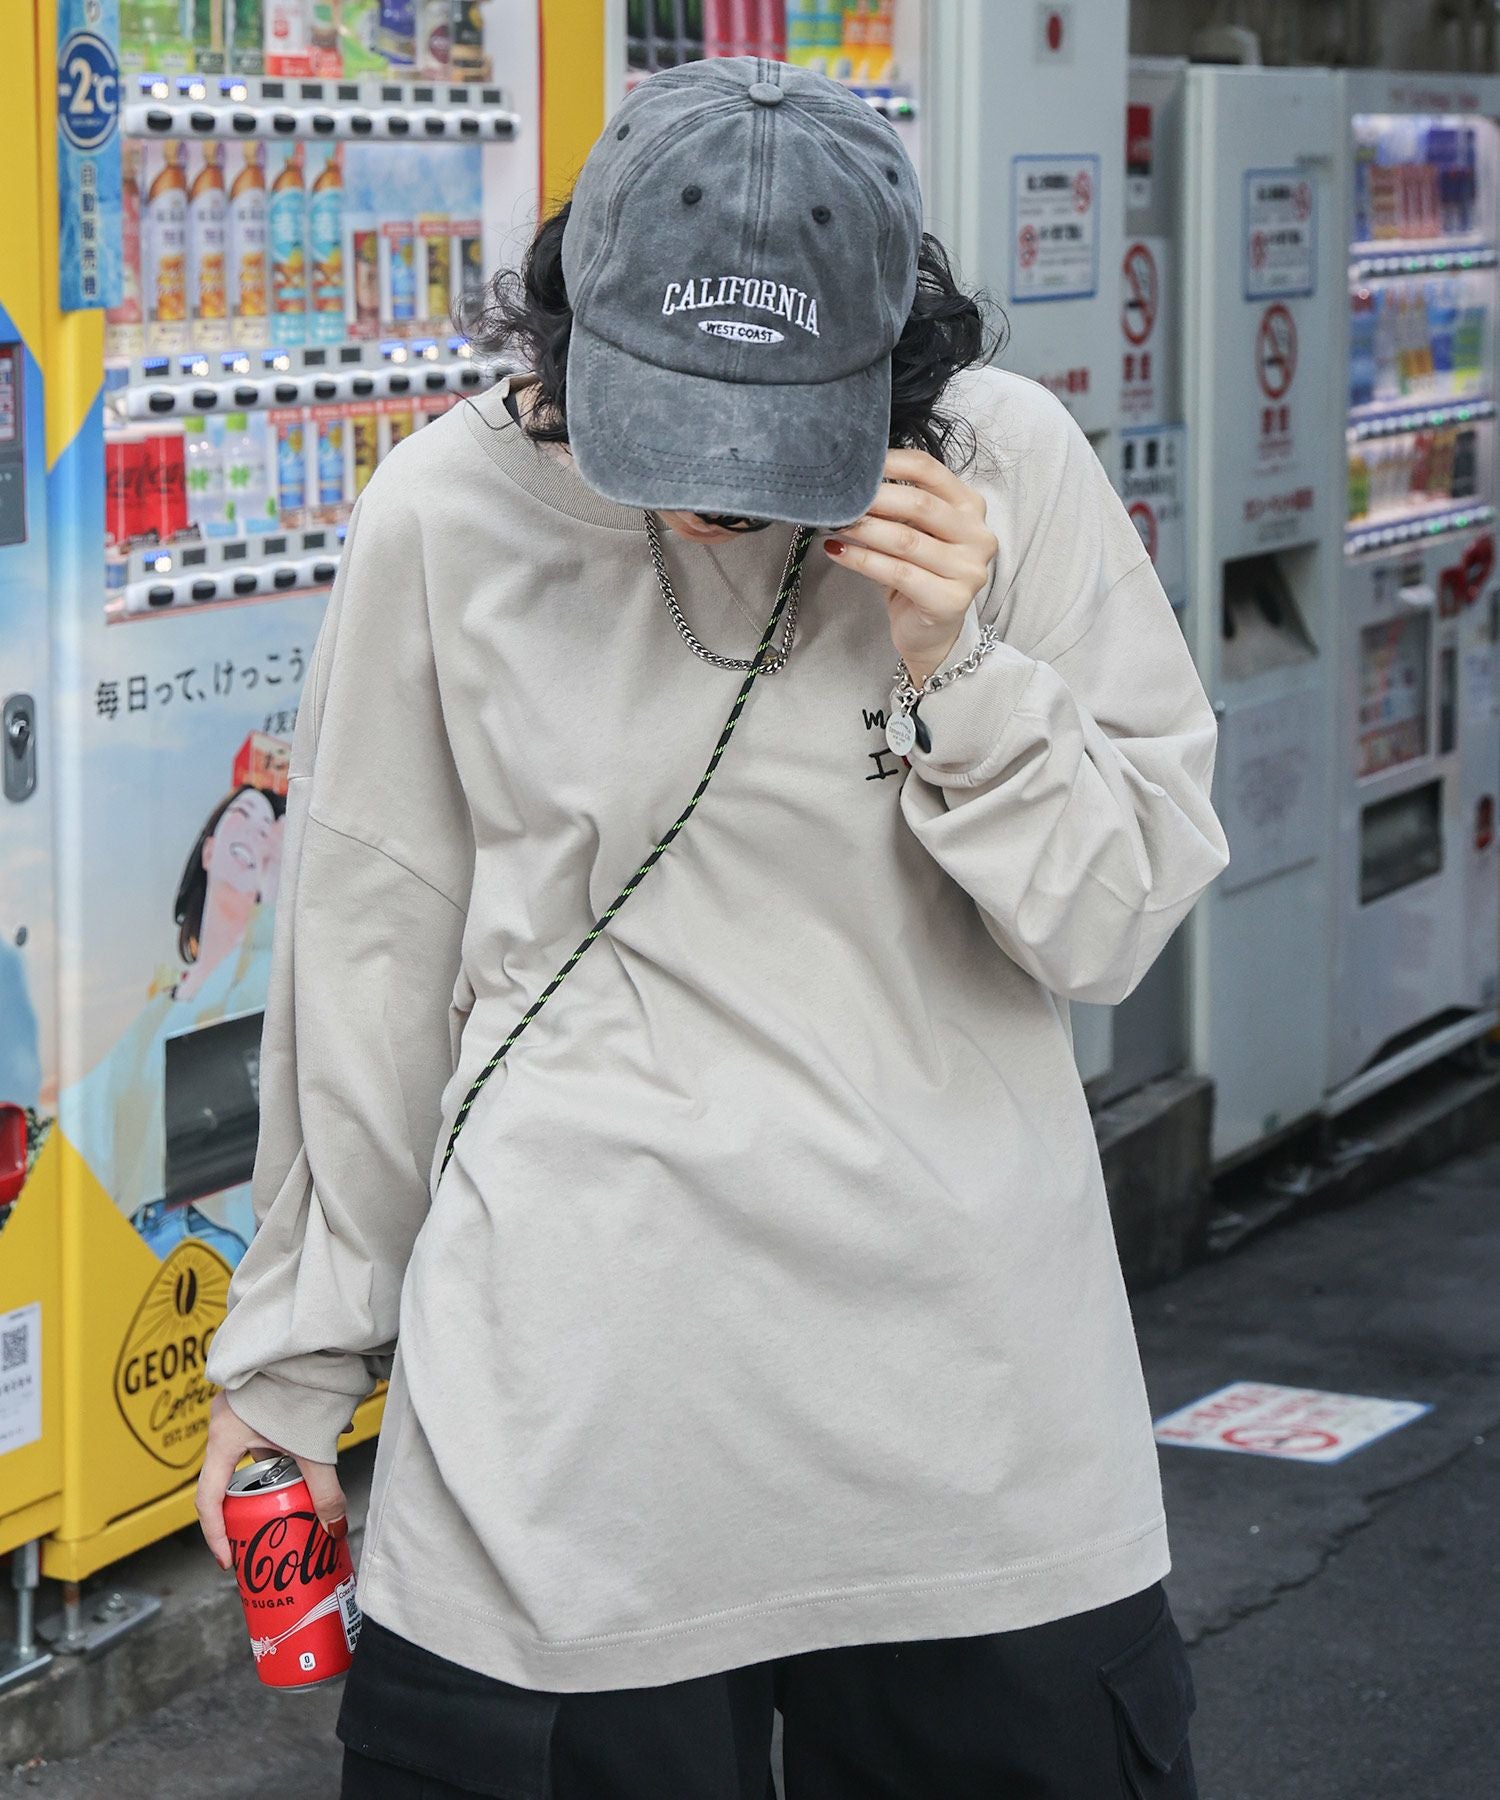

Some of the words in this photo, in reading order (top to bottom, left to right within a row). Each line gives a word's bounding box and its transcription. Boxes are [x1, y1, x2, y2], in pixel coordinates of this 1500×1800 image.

[662, 275, 821, 338] CALIFORNIA
[706, 322, 736, 337] WEST
[737, 327, 774, 343] COAST
[96, 647, 306, 721] 毎日って、けっこう
[252, 1596, 295, 1609] SUGAR
